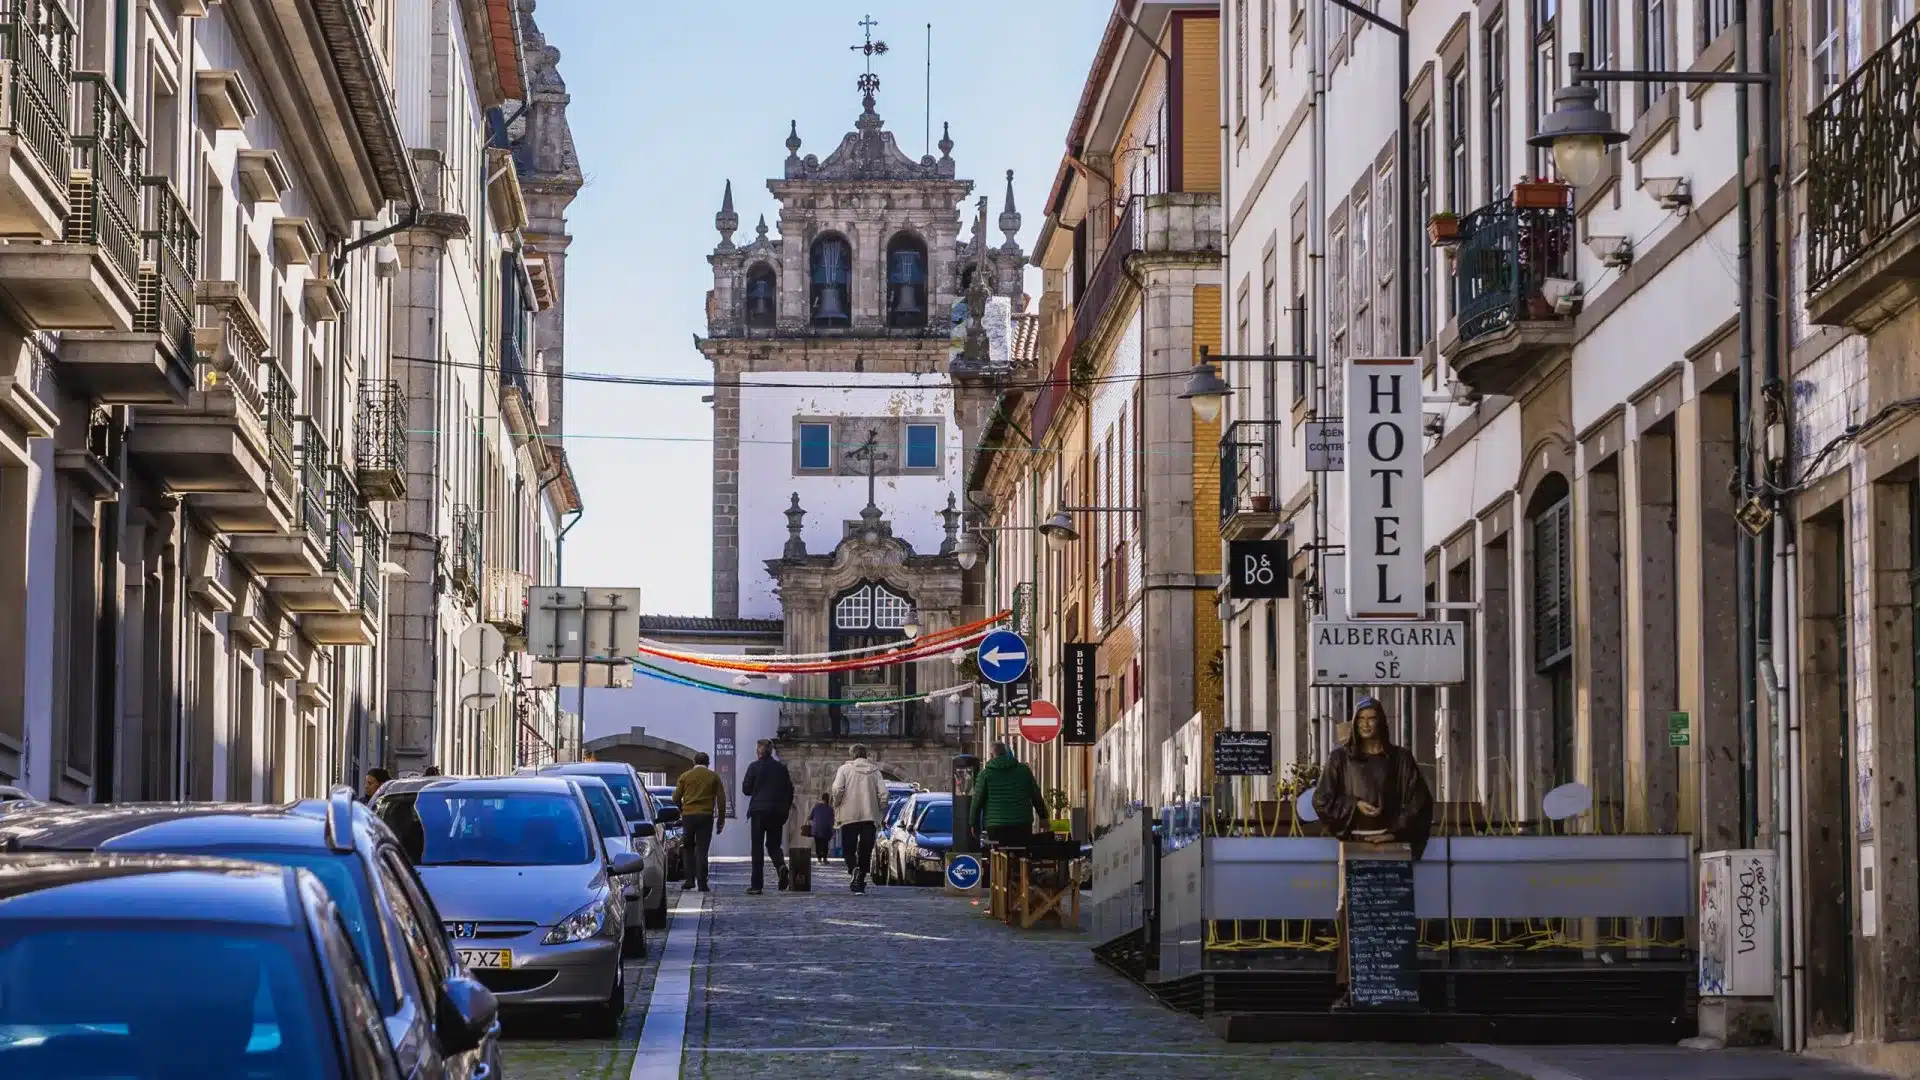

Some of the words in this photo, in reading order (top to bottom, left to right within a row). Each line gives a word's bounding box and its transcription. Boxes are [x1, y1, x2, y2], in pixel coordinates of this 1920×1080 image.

[1368, 375, 1404, 603] HOTEL
[1319, 628, 1456, 646] ALBERGARIA
[1374, 656, 1401, 679] SÉ
